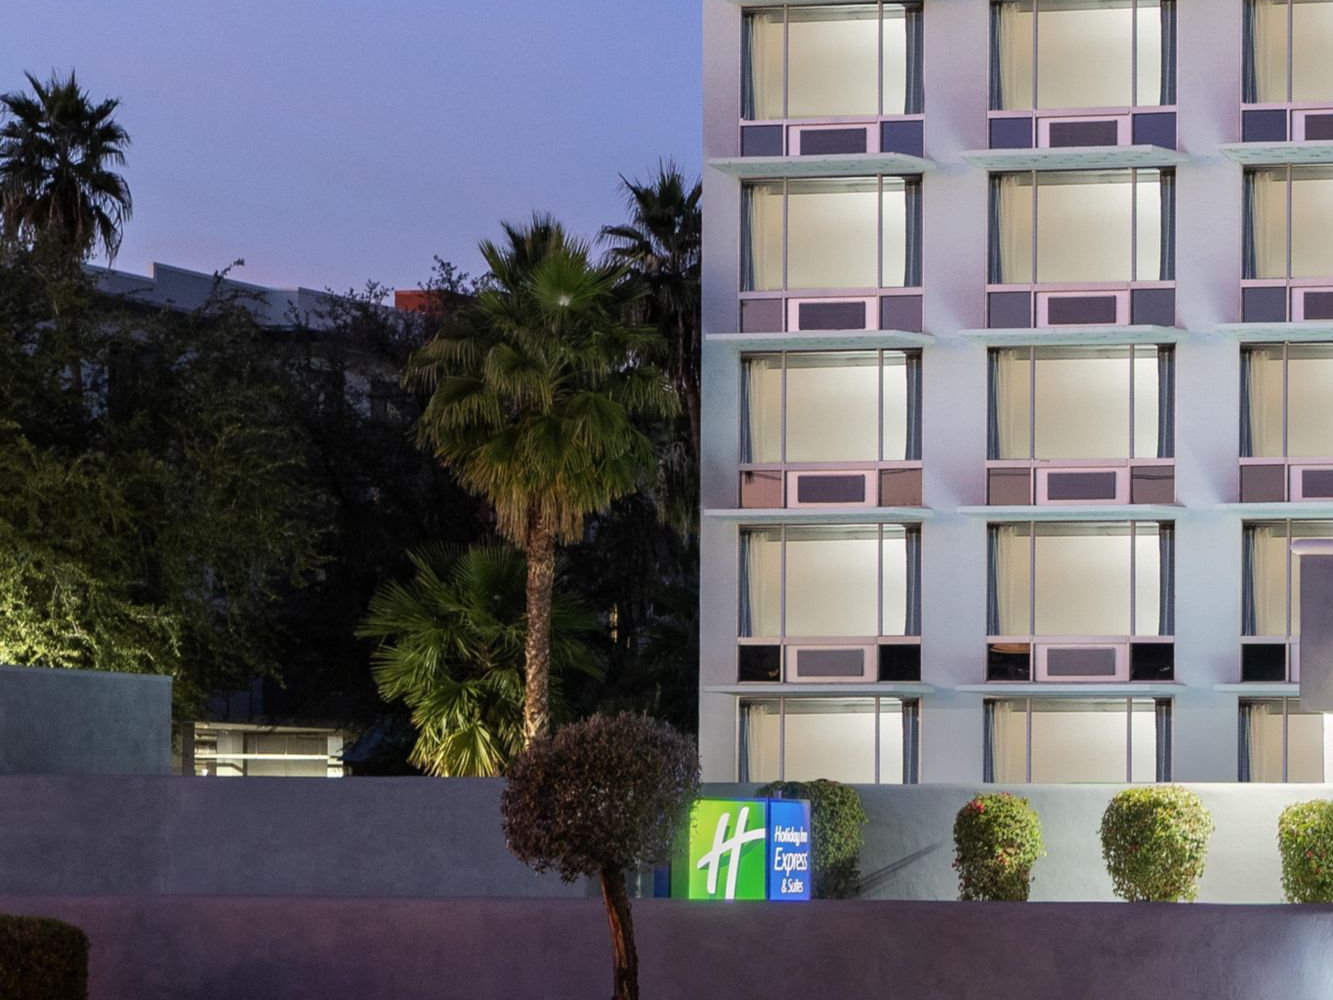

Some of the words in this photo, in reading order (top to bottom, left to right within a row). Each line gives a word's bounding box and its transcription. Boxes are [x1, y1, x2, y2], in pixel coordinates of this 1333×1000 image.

[774, 825, 800, 846] Holiday
[697, 807, 766, 901] H
[774, 847, 808, 877] Express
[781, 878, 787, 893] &
[787, 878, 804, 893] Suites
